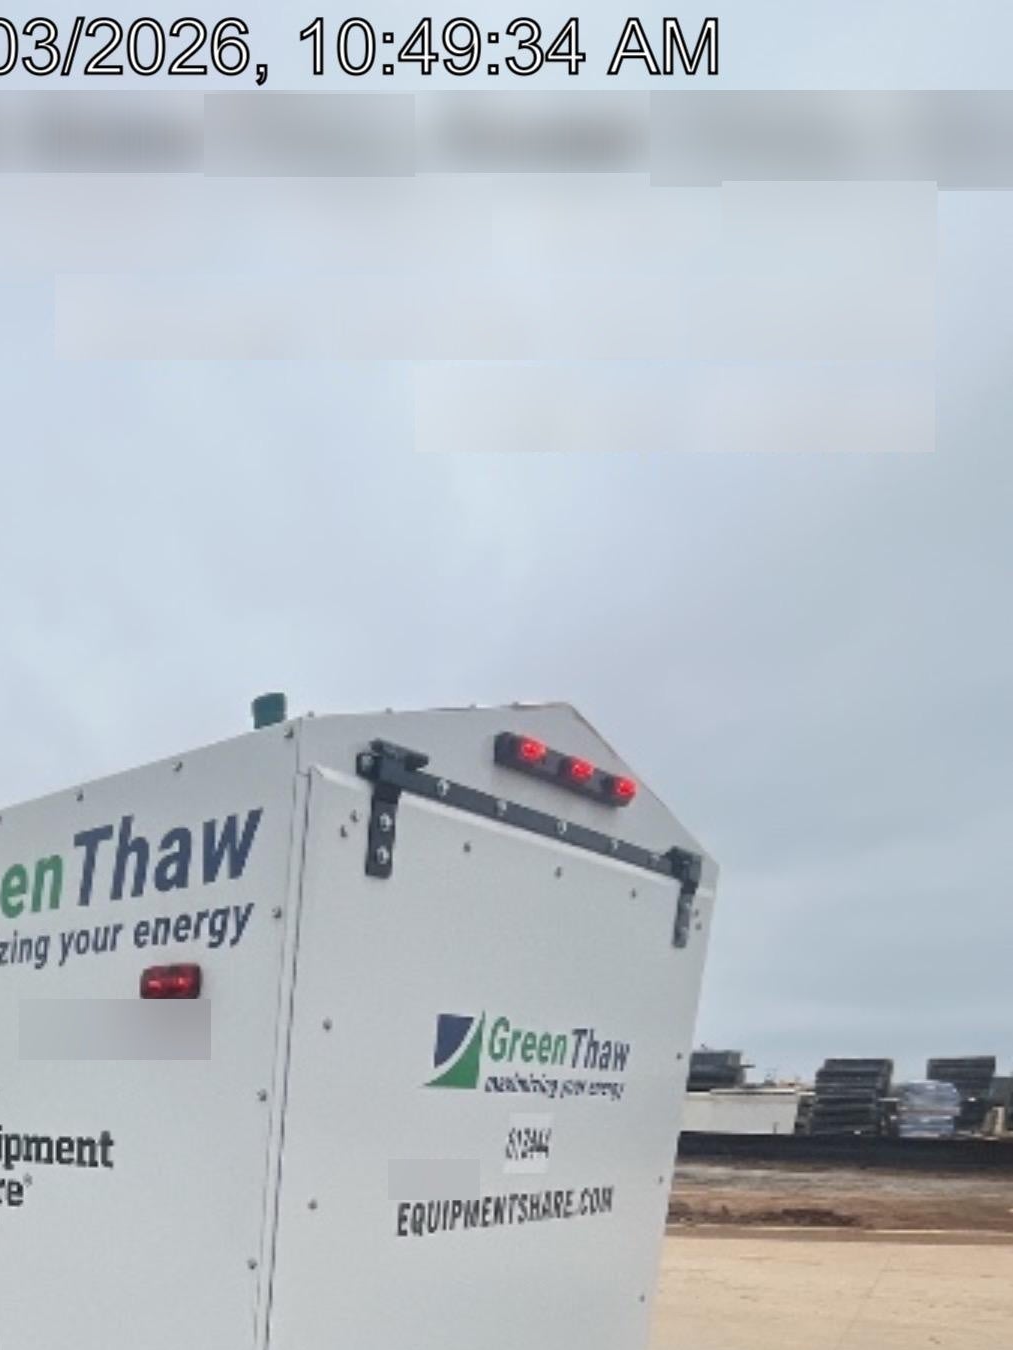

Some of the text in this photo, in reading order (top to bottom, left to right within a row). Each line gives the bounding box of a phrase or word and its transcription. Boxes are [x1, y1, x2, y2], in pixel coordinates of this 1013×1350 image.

[57, 923, 123, 968] your
[133, 902, 255, 949] energy
[395, 1185, 613, 1237] EQUIPMENTSHARE.COM
